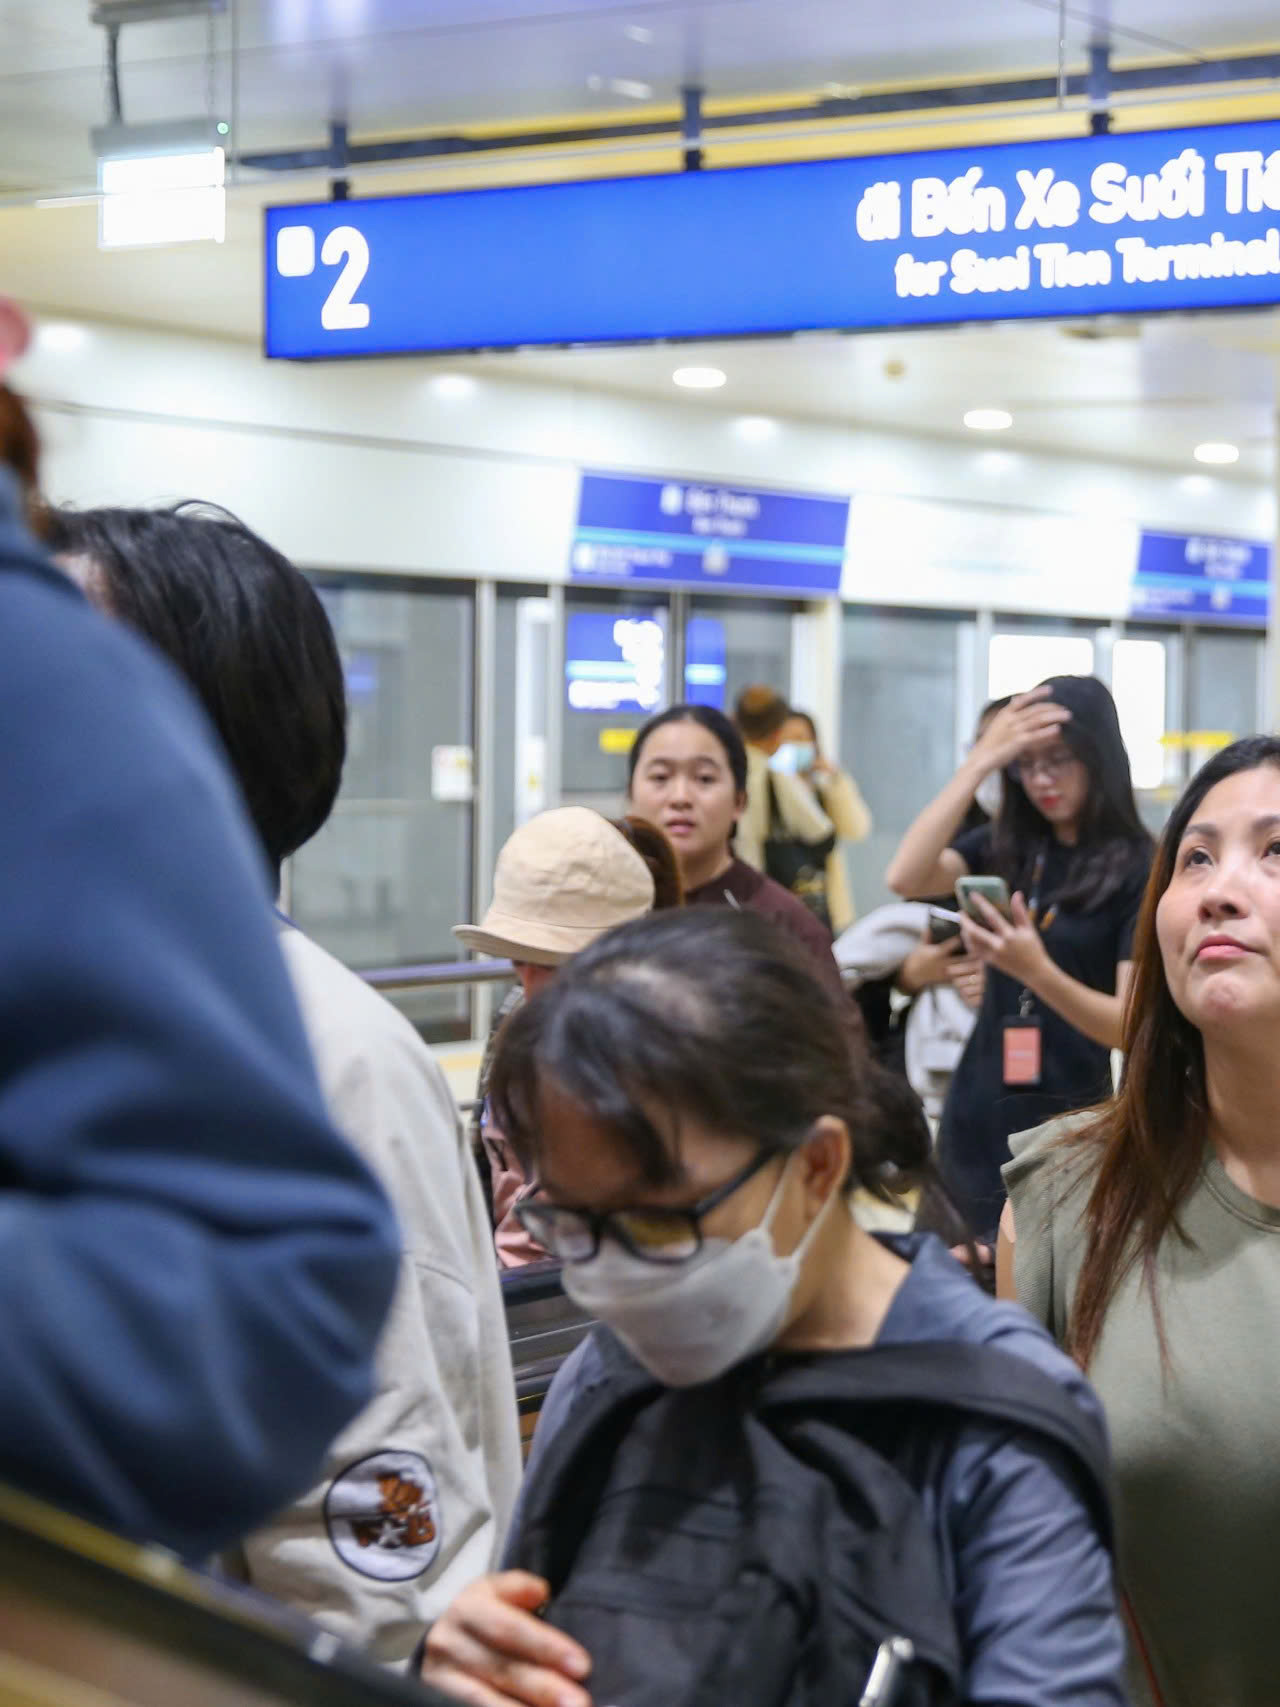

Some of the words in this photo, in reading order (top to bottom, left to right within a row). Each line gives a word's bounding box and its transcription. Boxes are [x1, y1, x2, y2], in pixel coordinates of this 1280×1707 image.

[911, 166, 1007, 238] Bến
[1014, 167, 1081, 230] Xe
[1088, 147, 1206, 225] Suối
[320, 226, 370, 330] 2
[894, 253, 948, 298] for
